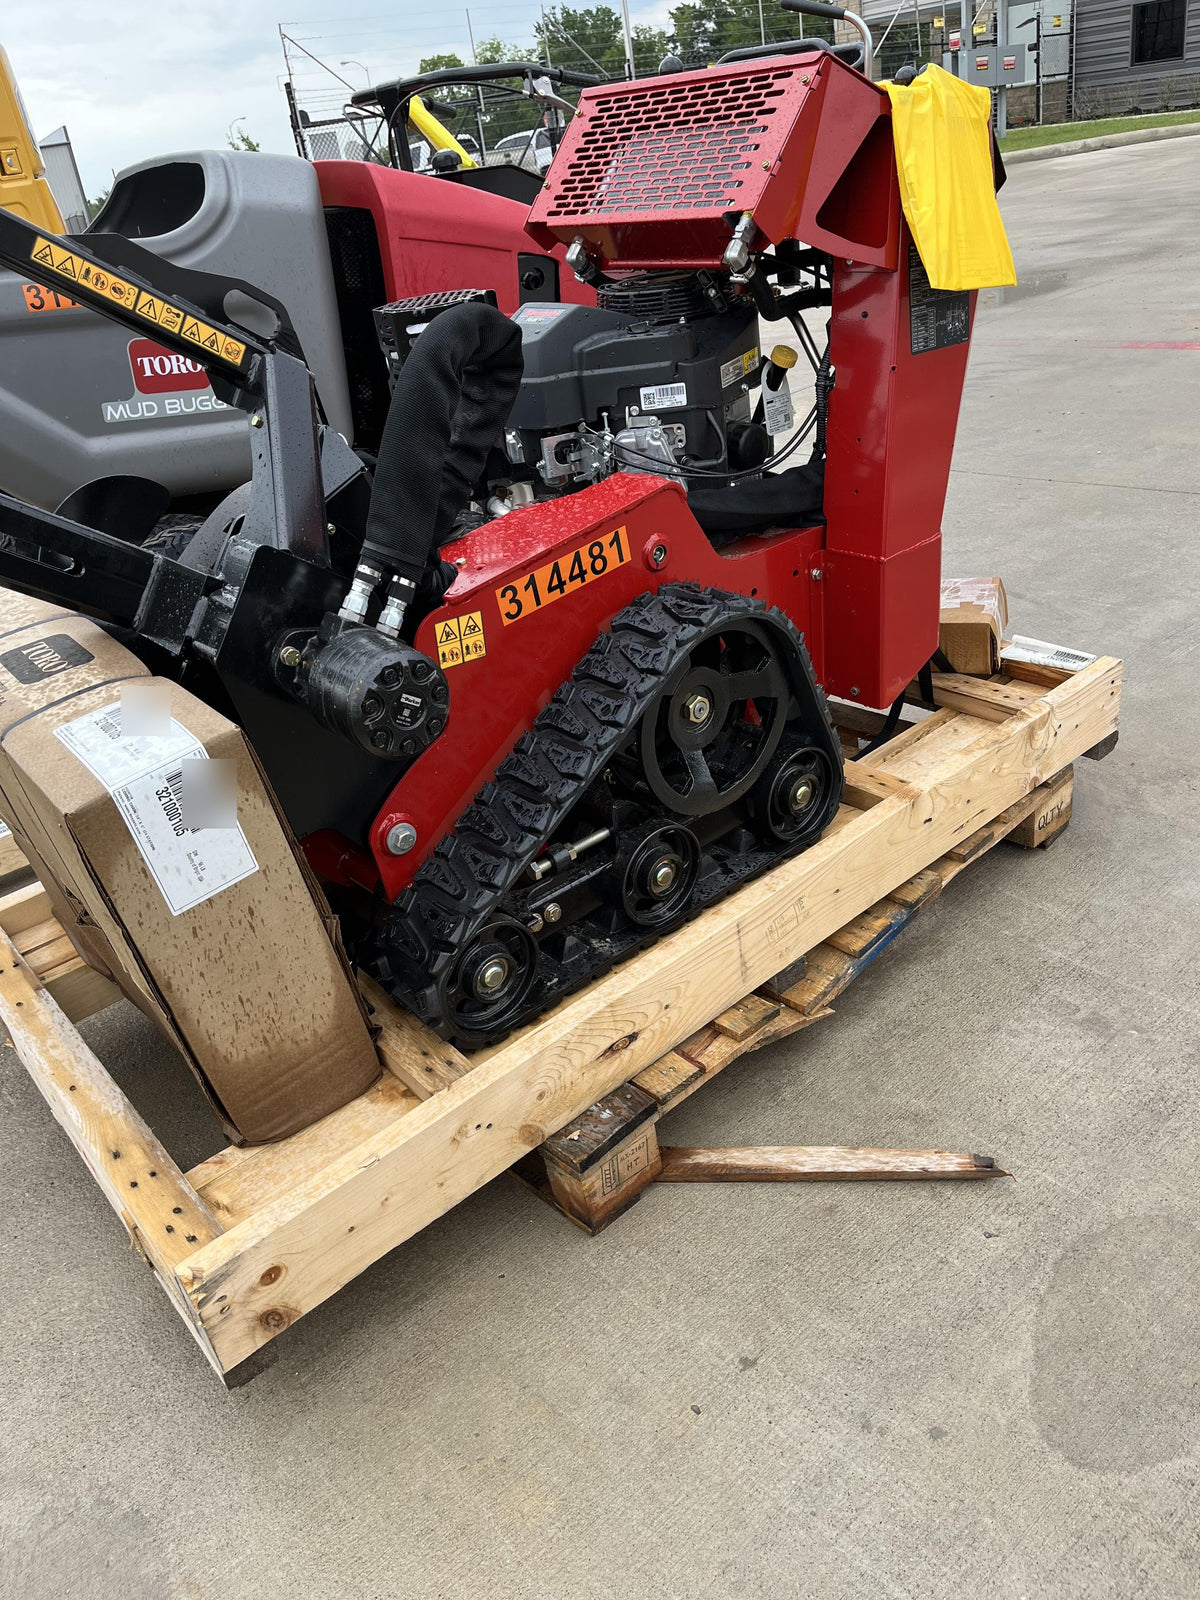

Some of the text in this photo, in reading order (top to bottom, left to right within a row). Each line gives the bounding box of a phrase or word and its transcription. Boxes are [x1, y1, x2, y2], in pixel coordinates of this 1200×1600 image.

[107, 401, 158, 420] MUD
[500, 530, 624, 620] 314481
[21, 641, 69, 673] TORO
[1038, 801, 1064, 830] QLTY
[626, 1157, 640, 1171] HT
